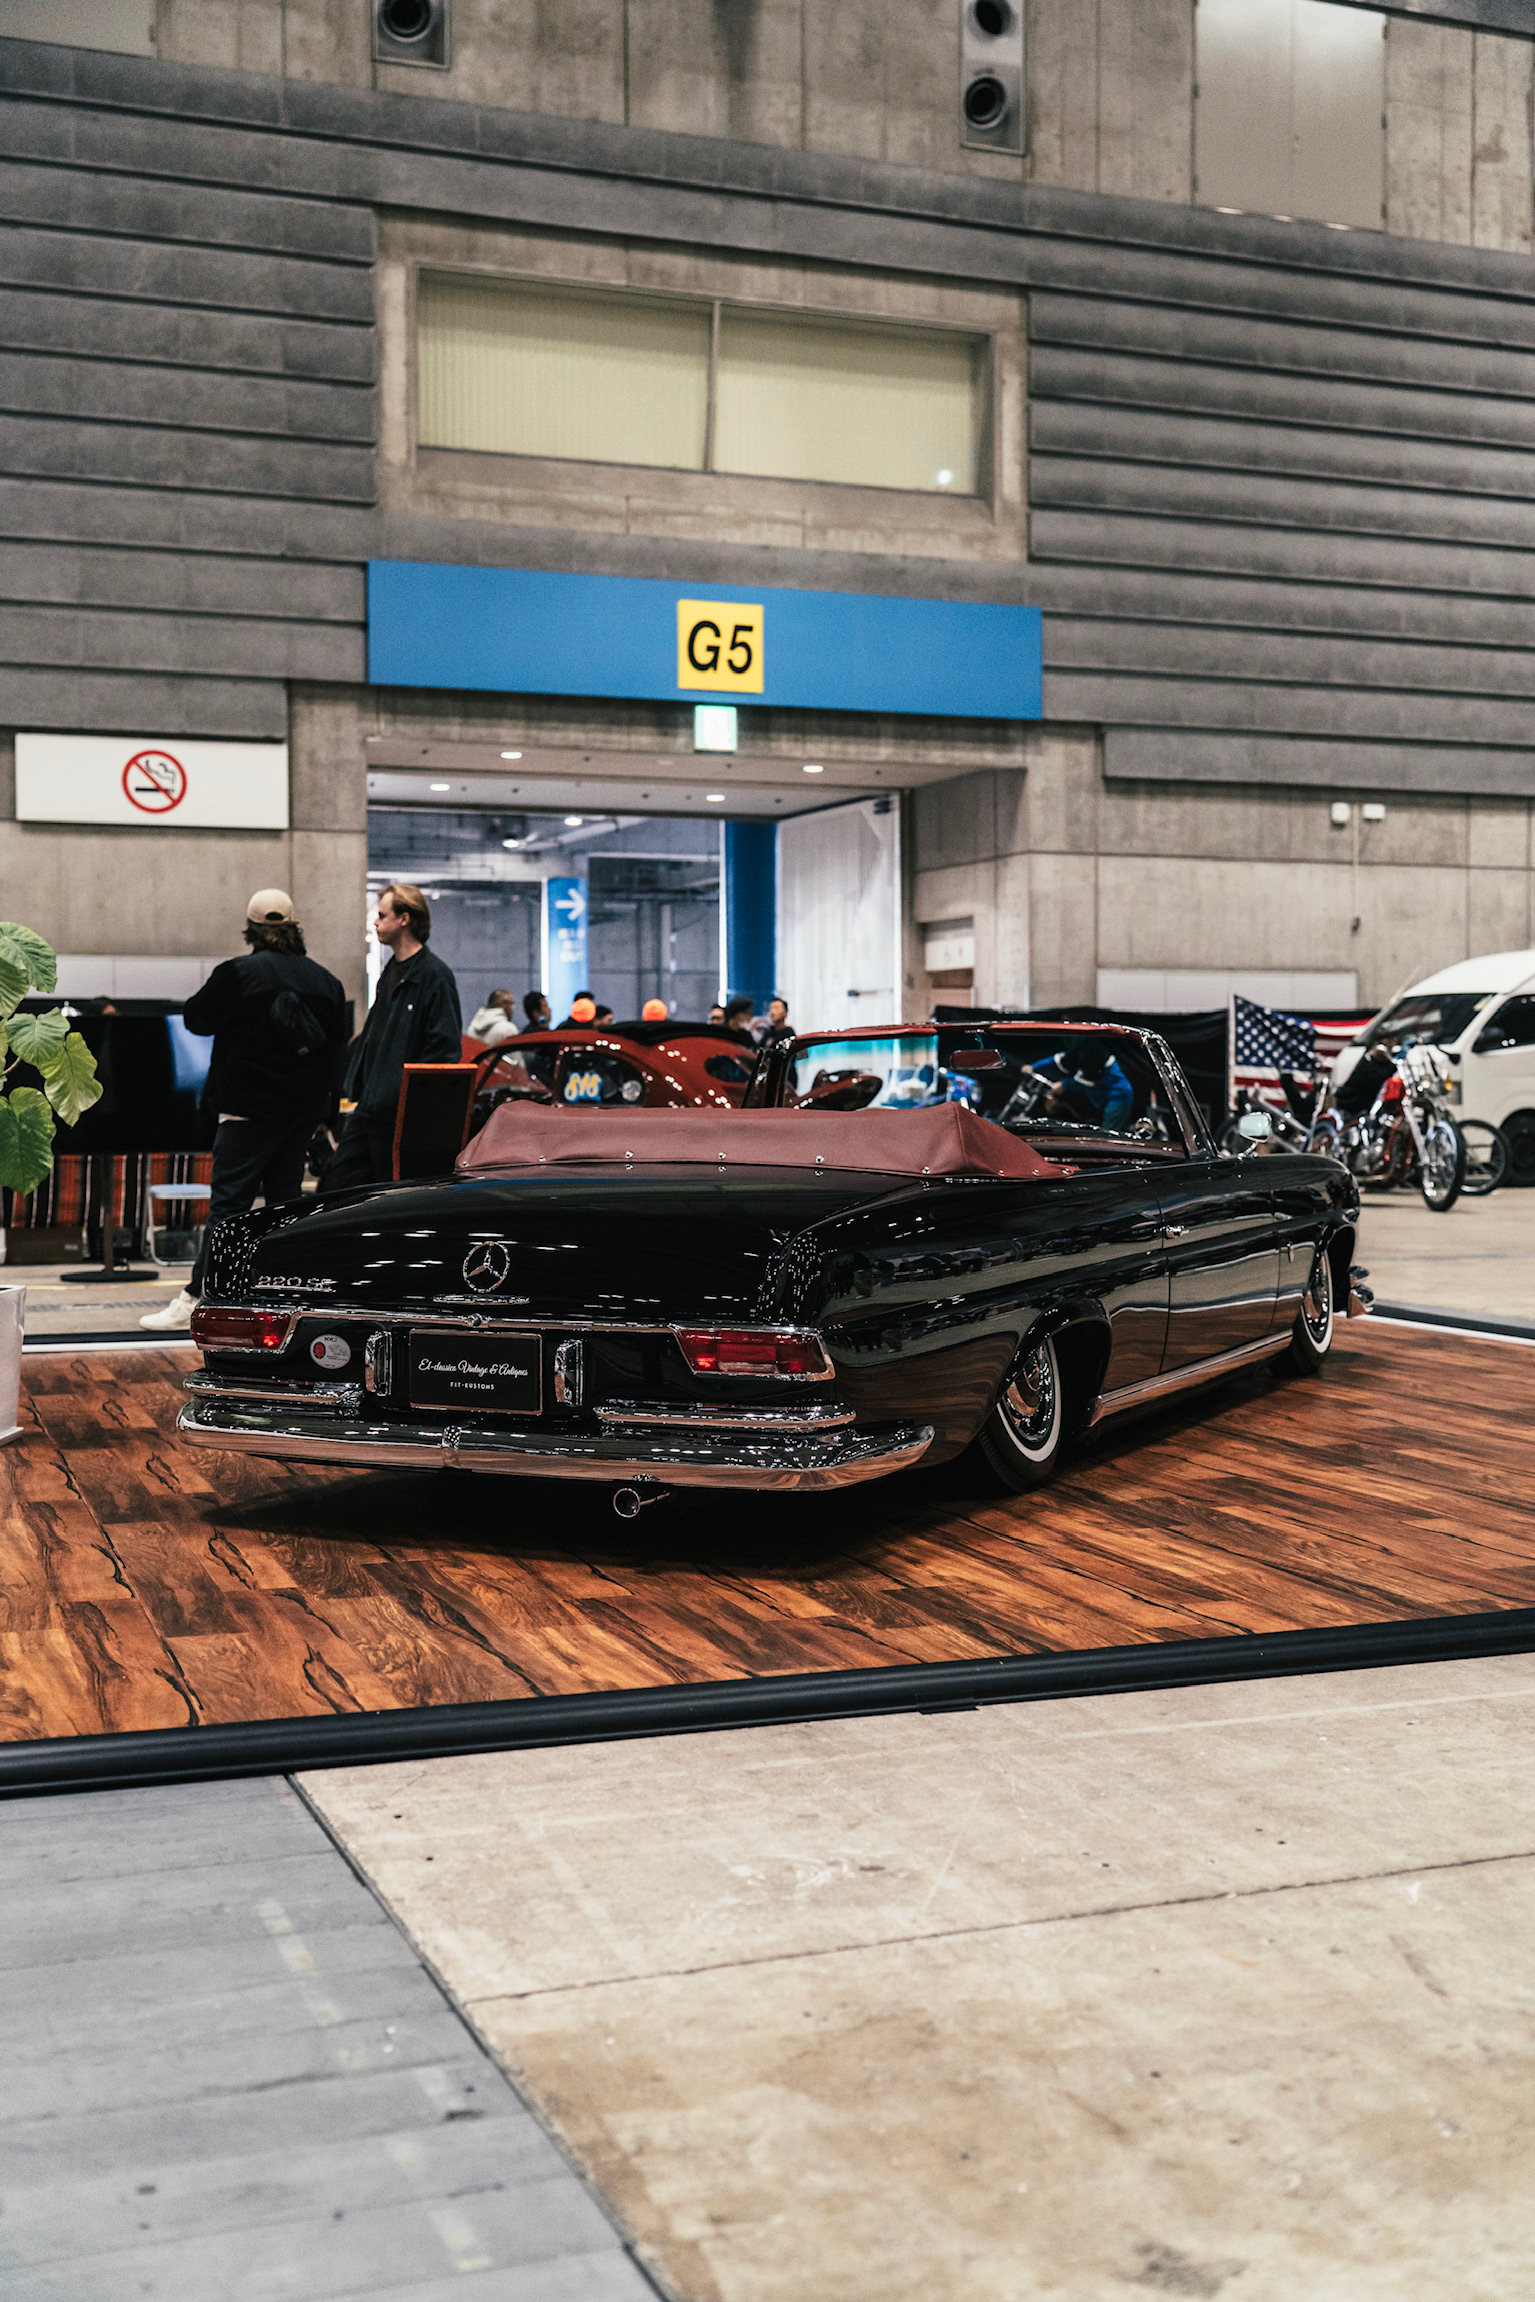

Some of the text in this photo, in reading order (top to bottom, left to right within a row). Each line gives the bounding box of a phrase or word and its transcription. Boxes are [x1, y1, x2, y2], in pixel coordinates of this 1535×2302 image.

[688, 620, 754, 674] G5
[457, 1360, 488, 1377] Vintage
[489, 1363, 498, 1375] &
[498, 1363, 528, 1378] Antiques
